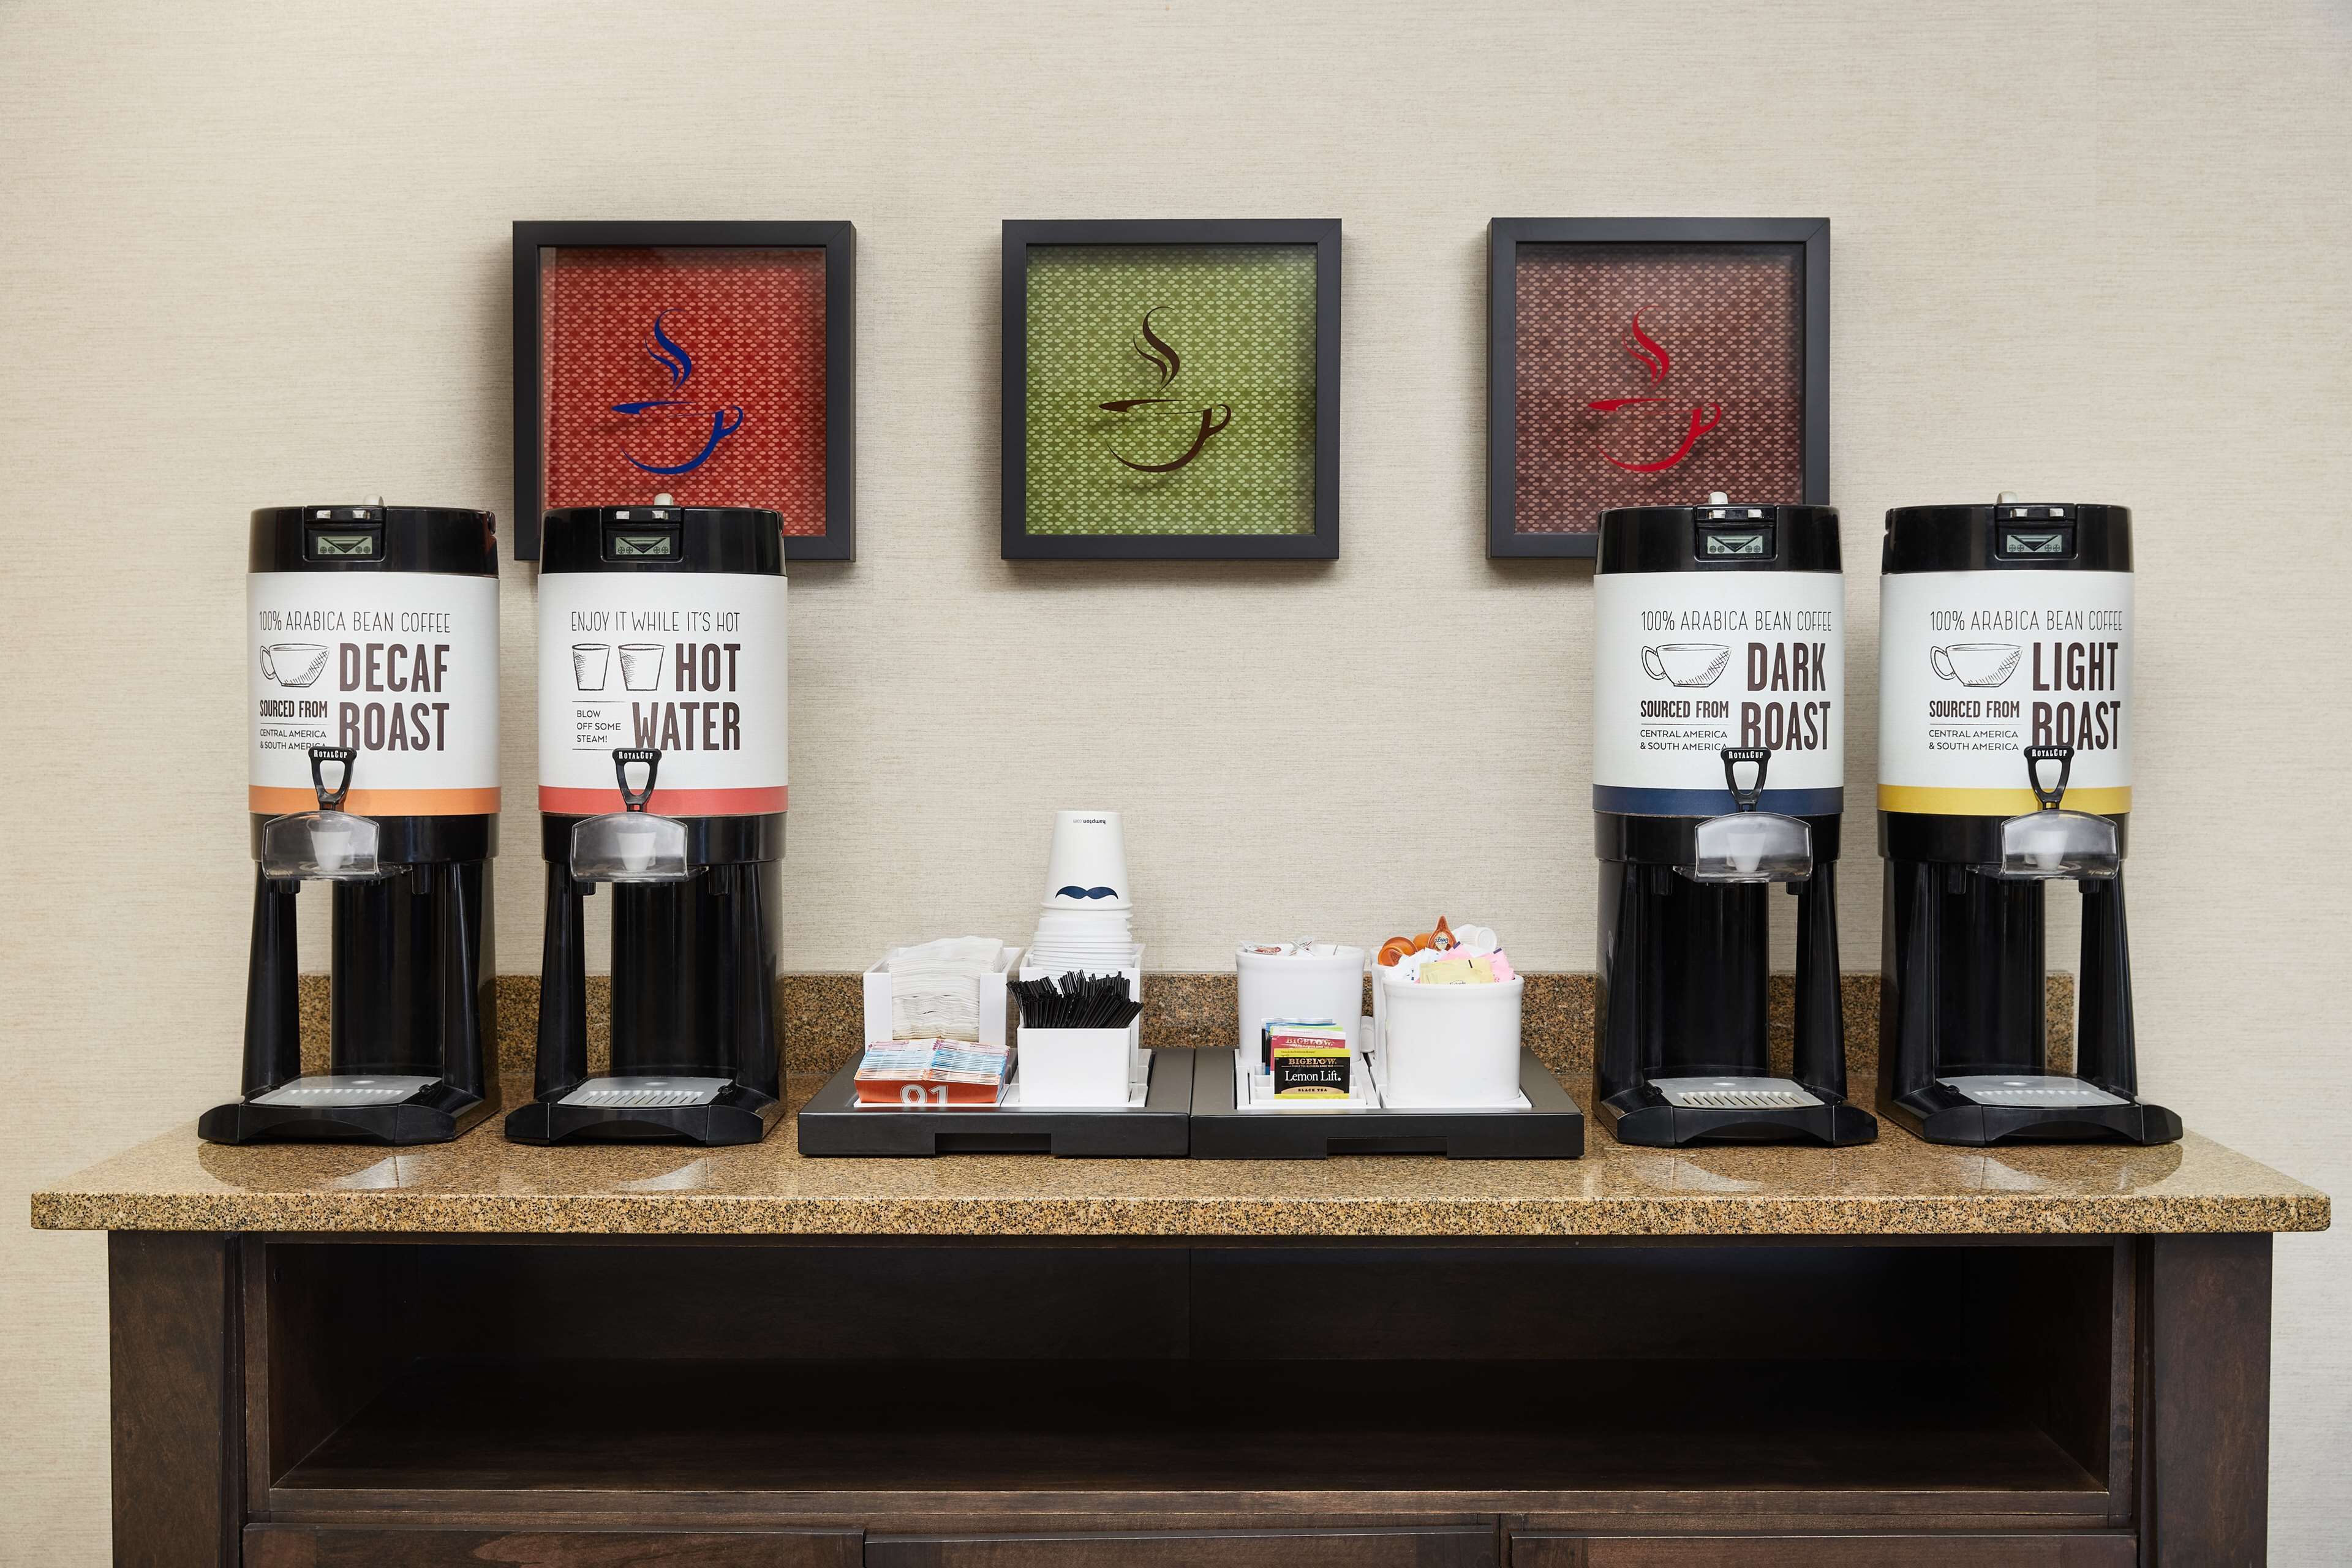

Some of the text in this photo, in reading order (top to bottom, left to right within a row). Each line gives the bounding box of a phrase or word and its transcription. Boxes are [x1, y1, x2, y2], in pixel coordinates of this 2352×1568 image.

[260, 611, 450, 633] 100% ARABICA BEAN COFFEE
[571, 611, 740, 631] ENJOY IT WHILE IT'S HOT
[1642, 611, 1831, 631] 100% ARABICA BEAN COFFEE
[1931, 611, 2122, 630] 100% ARABICA BEAN COFFEE
[340, 643, 450, 692] DECAF
[676, 643, 741, 692] HOT
[1747, 643, 1826, 691] DARK
[2033, 643, 2118, 691] LIGHT
[260, 699, 327, 718] SOURCED FROM
[1641, 700, 1728, 718] SOURCED FROM
[1929, 701, 2019, 718] SOURCED FROM
[260, 728, 327, 738] CENTRAL AMERICA
[340, 702, 450, 750] ROAST
[576, 722, 622, 731] OFF SOME
[632, 702, 740, 750] WATER
[1640, 729, 1728, 739] CENTRAL AMERICA
[1742, 701, 1830, 750] ROAST
[1929, 729, 2019, 739] CENTRAL AMERICA
[2032, 701, 2120, 750] ROAST
[260, 741, 264, 749] &
[264, 741, 287, 750] SOUTH
[576, 734, 608, 743] STEAM!
[1648, 742, 1679, 750] SOUTH
[1681, 741, 1728, 751] AMERICA
[1937, 742, 1969, 750] SOUTH
[1972, 742, 2019, 751] AMERICA
[314, 749, 347, 758] ROYALCUP
[619, 751, 653, 760] ROYALCUP
[1728, 750, 1763, 759] ROYALCUP
[2032, 748, 2067, 757] ROYALCUP
[1285, 1038, 1333, 1046] BIGELOW
[1285, 1071, 1319, 1081] Lemon
